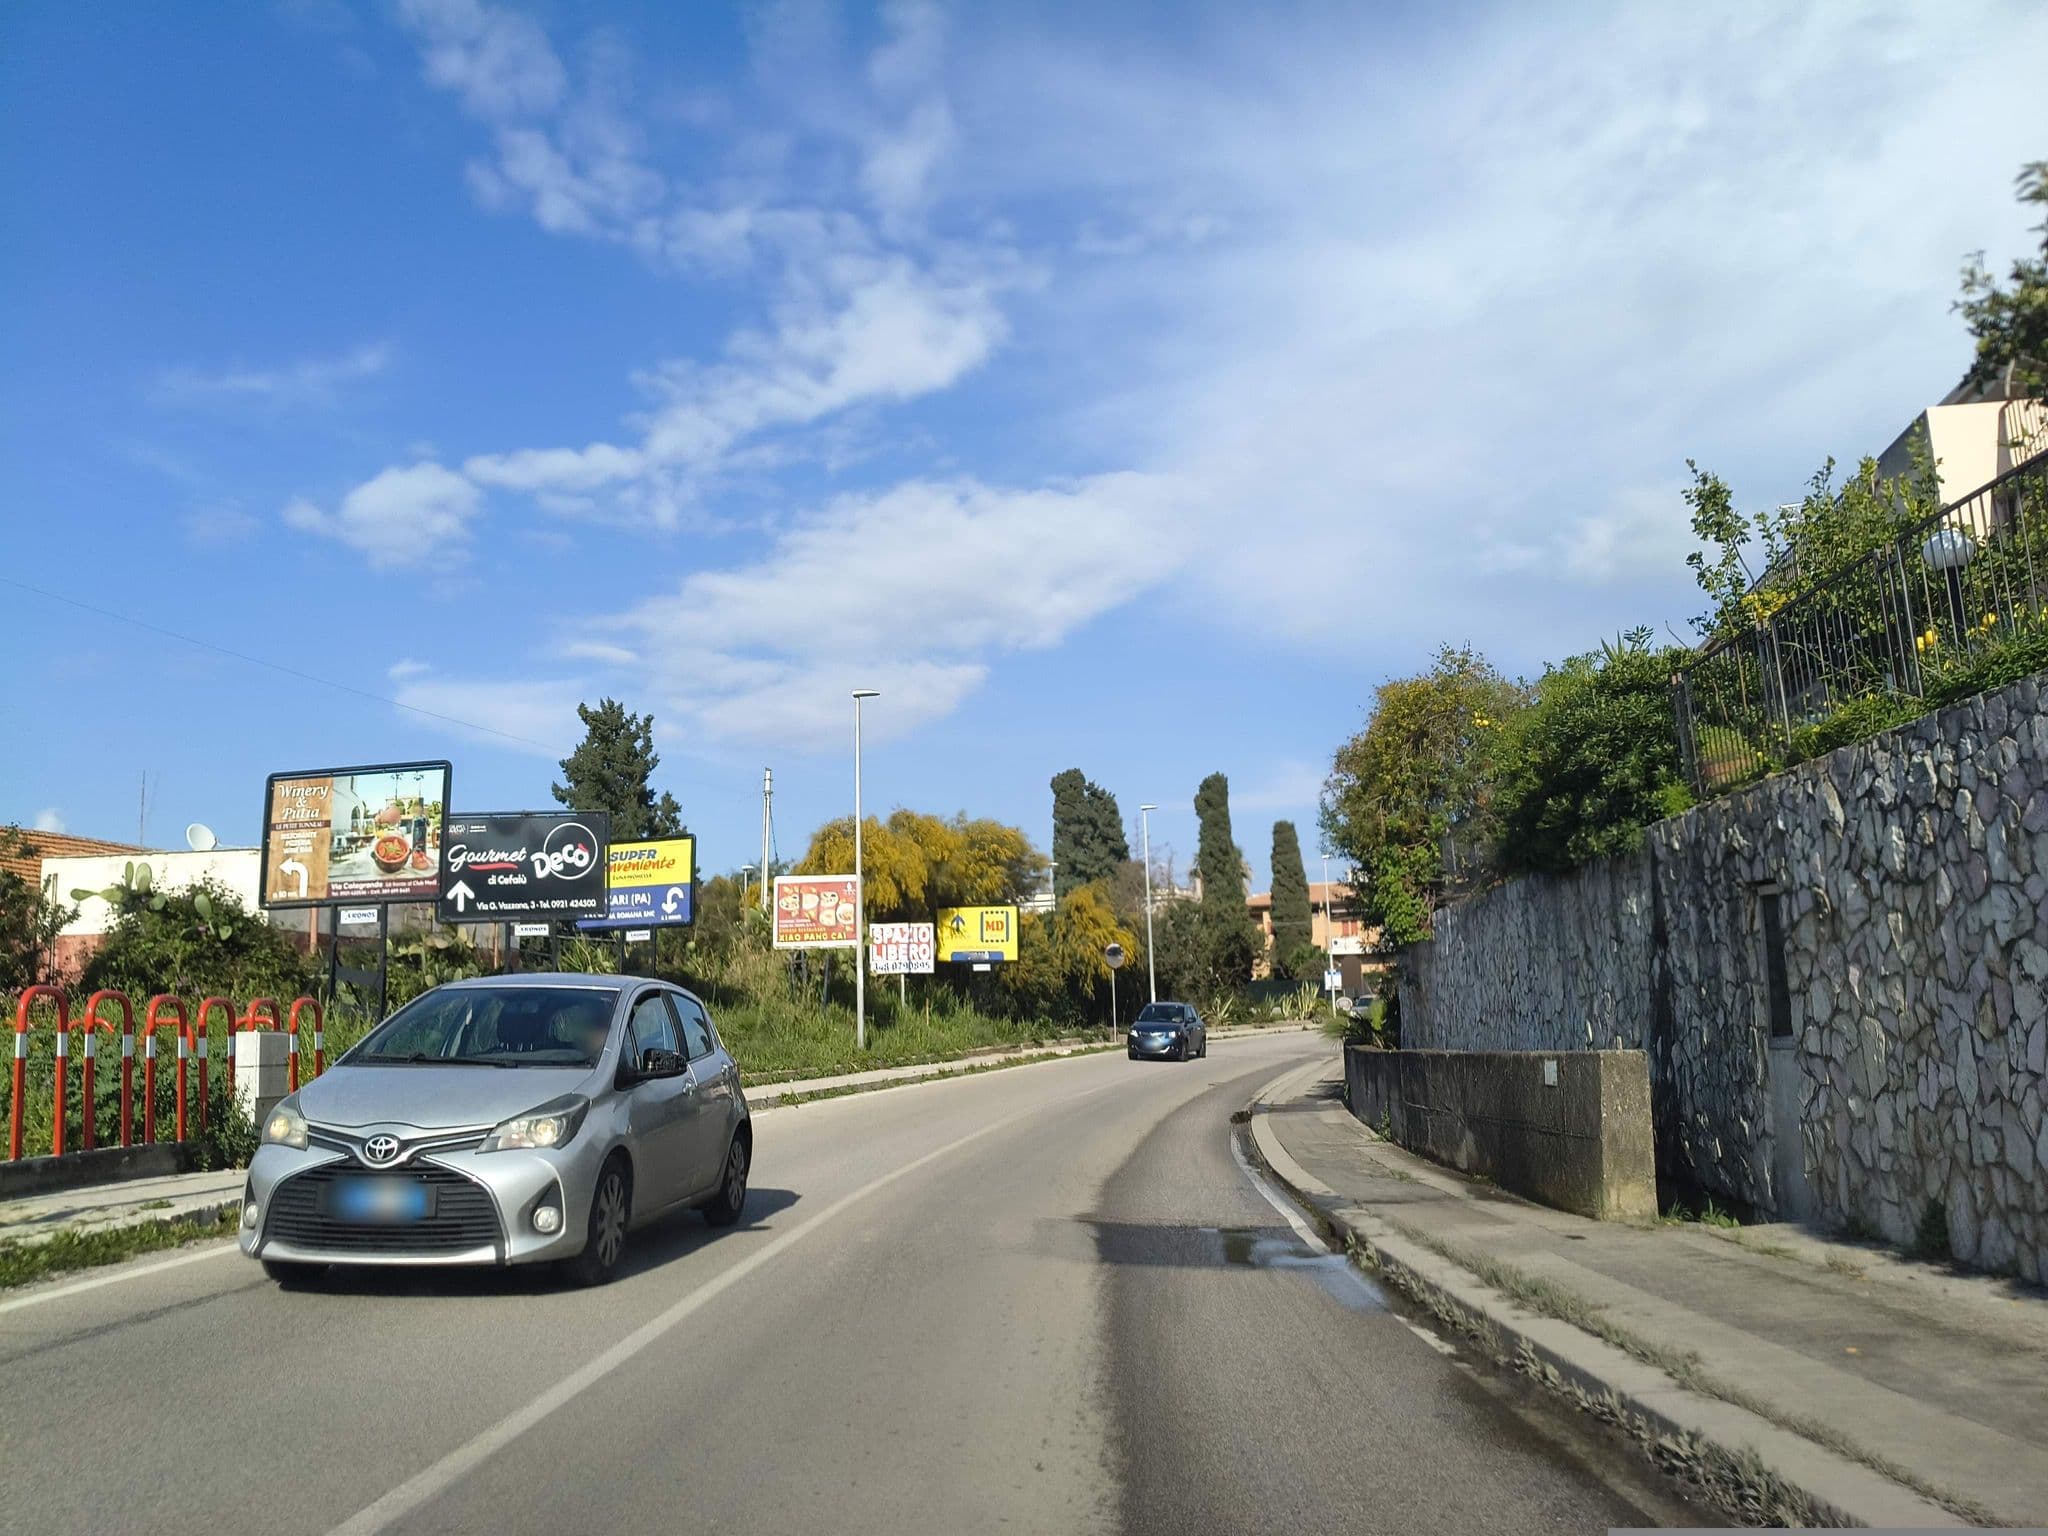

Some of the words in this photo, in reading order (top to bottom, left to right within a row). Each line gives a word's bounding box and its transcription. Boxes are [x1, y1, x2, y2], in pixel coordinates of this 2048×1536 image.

[278, 785, 328, 800] Winery
[296, 796, 307, 808] &
[282, 807, 320, 820] Putia
[448, 844, 527, 872] Gourmet
[609, 856, 676, 873] nveniente
[488, 874, 497, 886] di
[498, 874, 527, 886] Cefalù
[476, 901, 488, 911] Via
[530, 900, 536, 909] 3
[550, 900, 568, 909] 0921
[631, 892, 652, 907] (PA)
[985, 920, 1005, 932] MD
[779, 933, 801, 942] XIAO
[831, 931, 847, 940] CAI
[872, 926, 931, 944] SPAZIO
[872, 943, 931, 961] LIBERO
